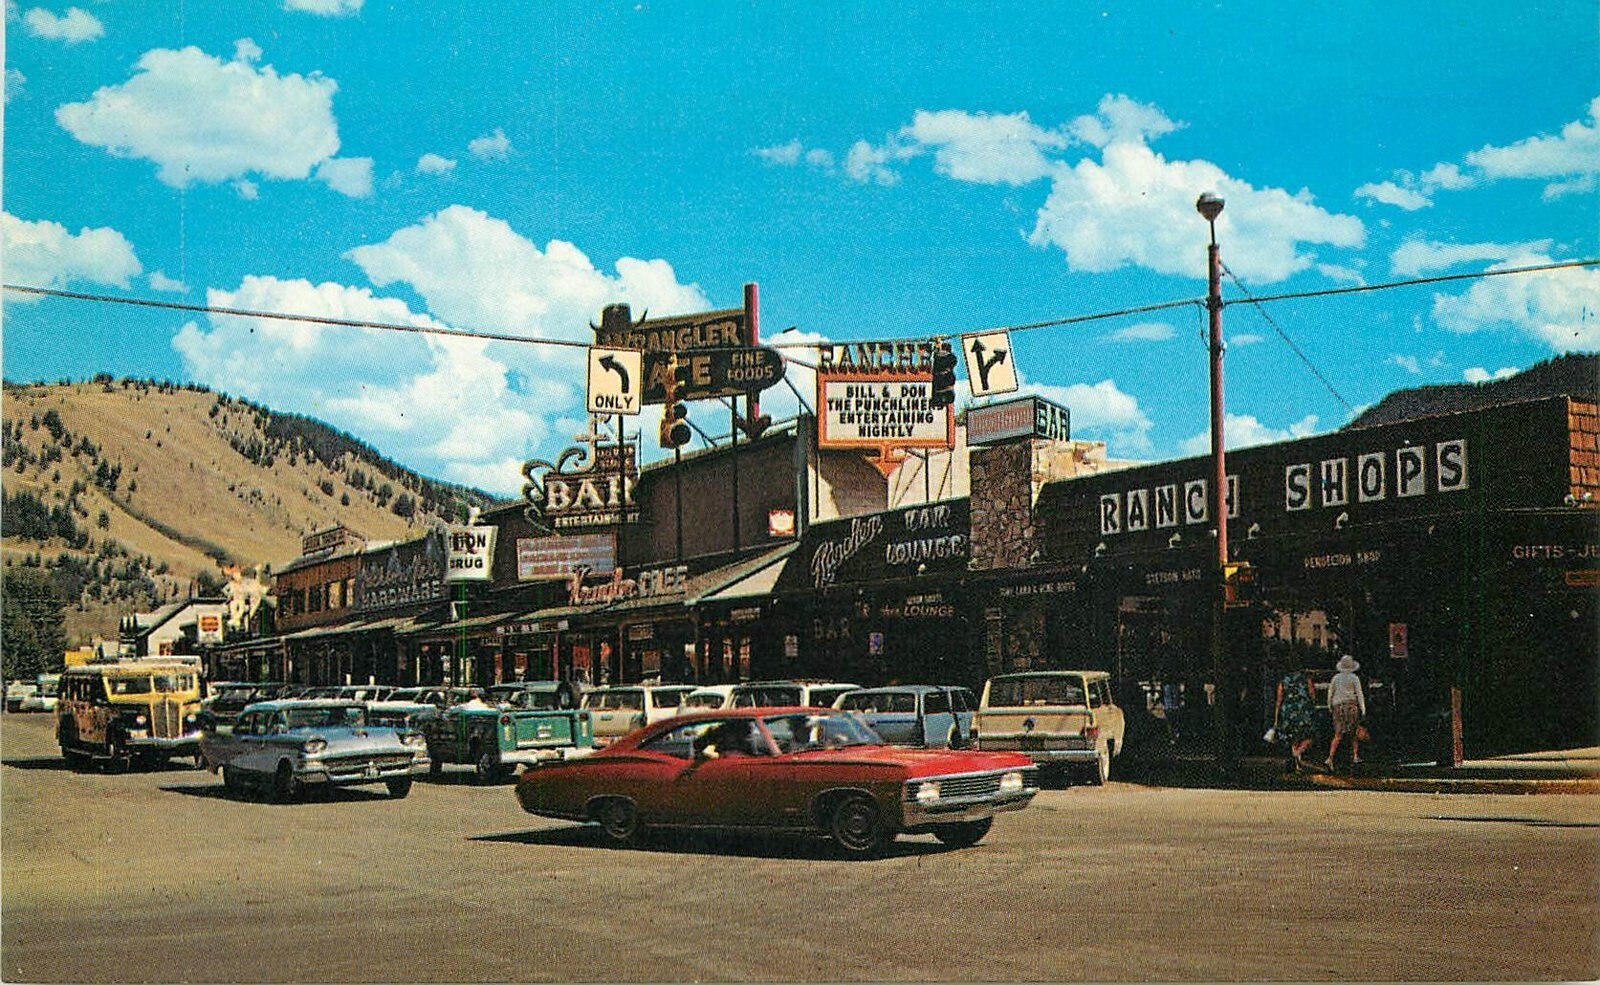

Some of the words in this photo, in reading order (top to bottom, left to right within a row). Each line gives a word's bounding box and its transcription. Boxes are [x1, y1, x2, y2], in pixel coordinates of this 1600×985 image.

[731, 352, 765, 366] FINE
[819, 342, 951, 373] RANCHE
[726, 364, 774, 381] FOODS
[846, 384, 876, 398] BILL
[901, 384, 926, 397] DON
[594, 395, 633, 410] ONLY
[827, 399, 852, 411] THE
[839, 411, 934, 425] ENTERTAINING
[1038, 401, 1069, 441] BAR
[858, 425, 914, 438] NIGHTLY
[1287, 441, 1467, 510] SHOPS
[554, 511, 640, 528] ENTERTAINMNT
[886, 535, 968, 565] LOUNGE
[449, 557, 484, 569] DRUG
